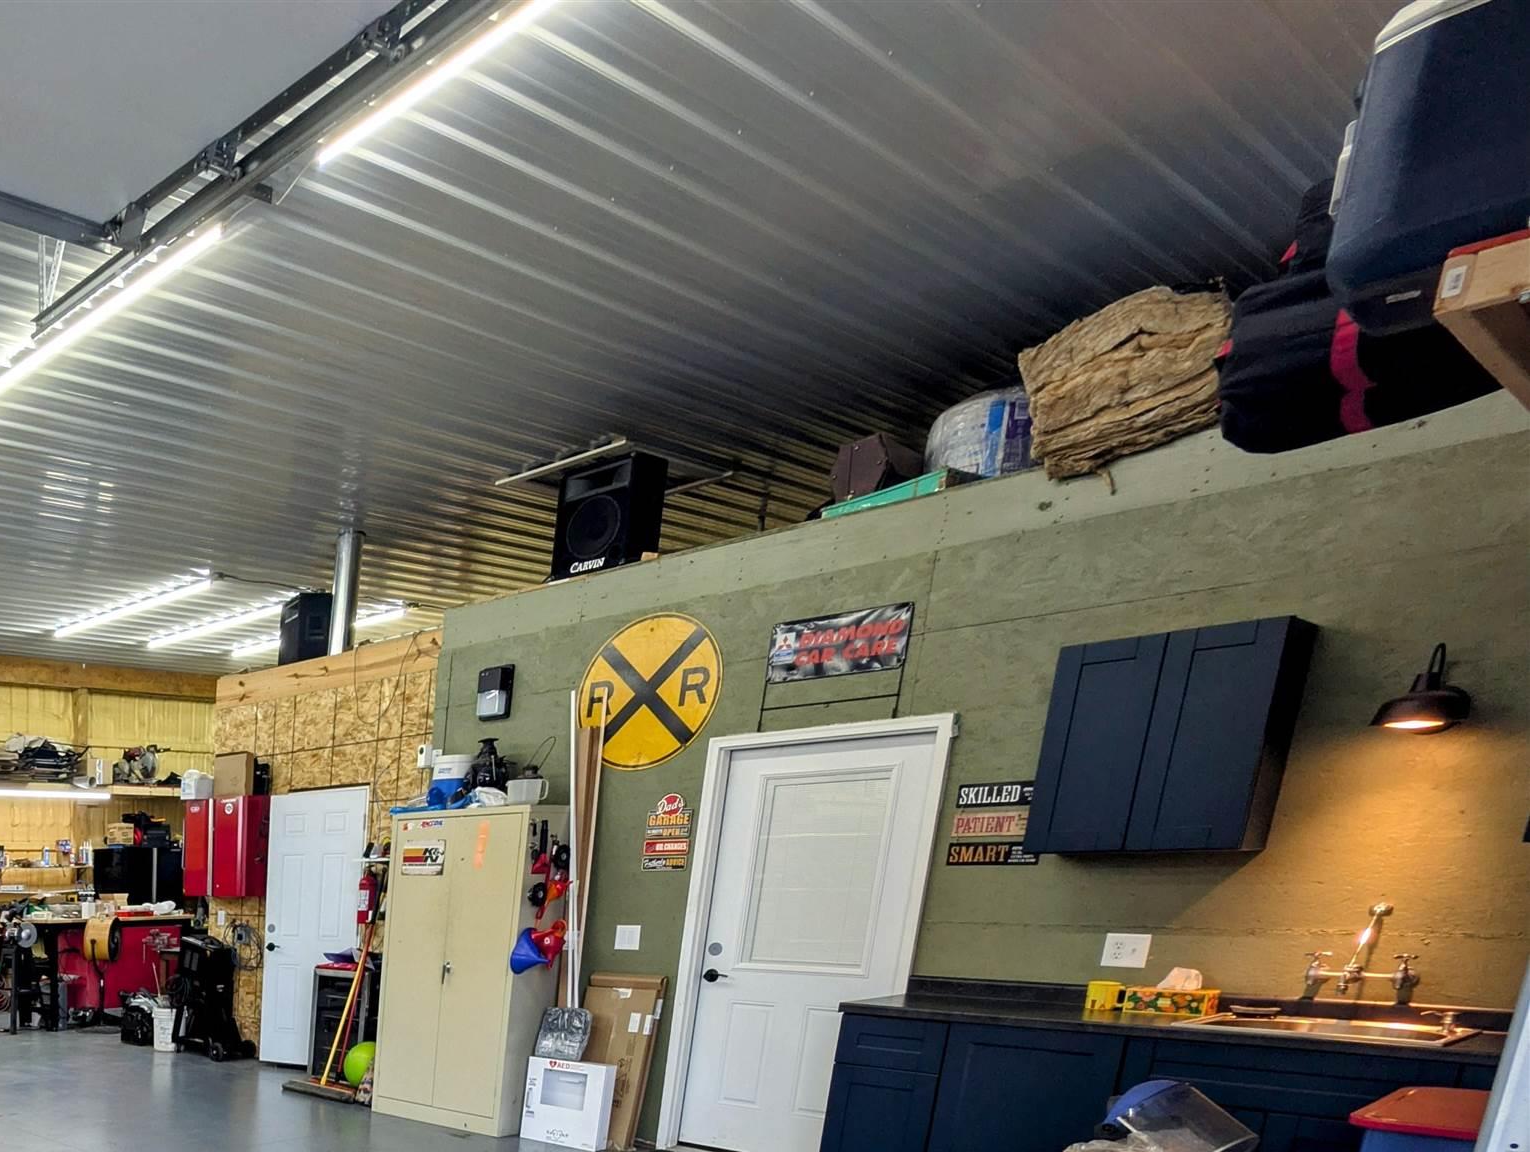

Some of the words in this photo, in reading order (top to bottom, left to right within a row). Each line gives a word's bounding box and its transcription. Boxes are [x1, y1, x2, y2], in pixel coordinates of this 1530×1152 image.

[570, 556, 605, 573] CARVIN
[798, 619, 905, 649] DIAMOND
[793, 647, 836, 667] CAR
[842, 638, 898, 659] CARE
[678, 666, 711, 707] R
[958, 784, 1021, 805] SKILLED
[656, 797, 684, 815] Dad's
[648, 813, 690, 826] GARAGE
[954, 815, 1016, 834] PATIENT
[949, 845, 1010, 863] SMART
